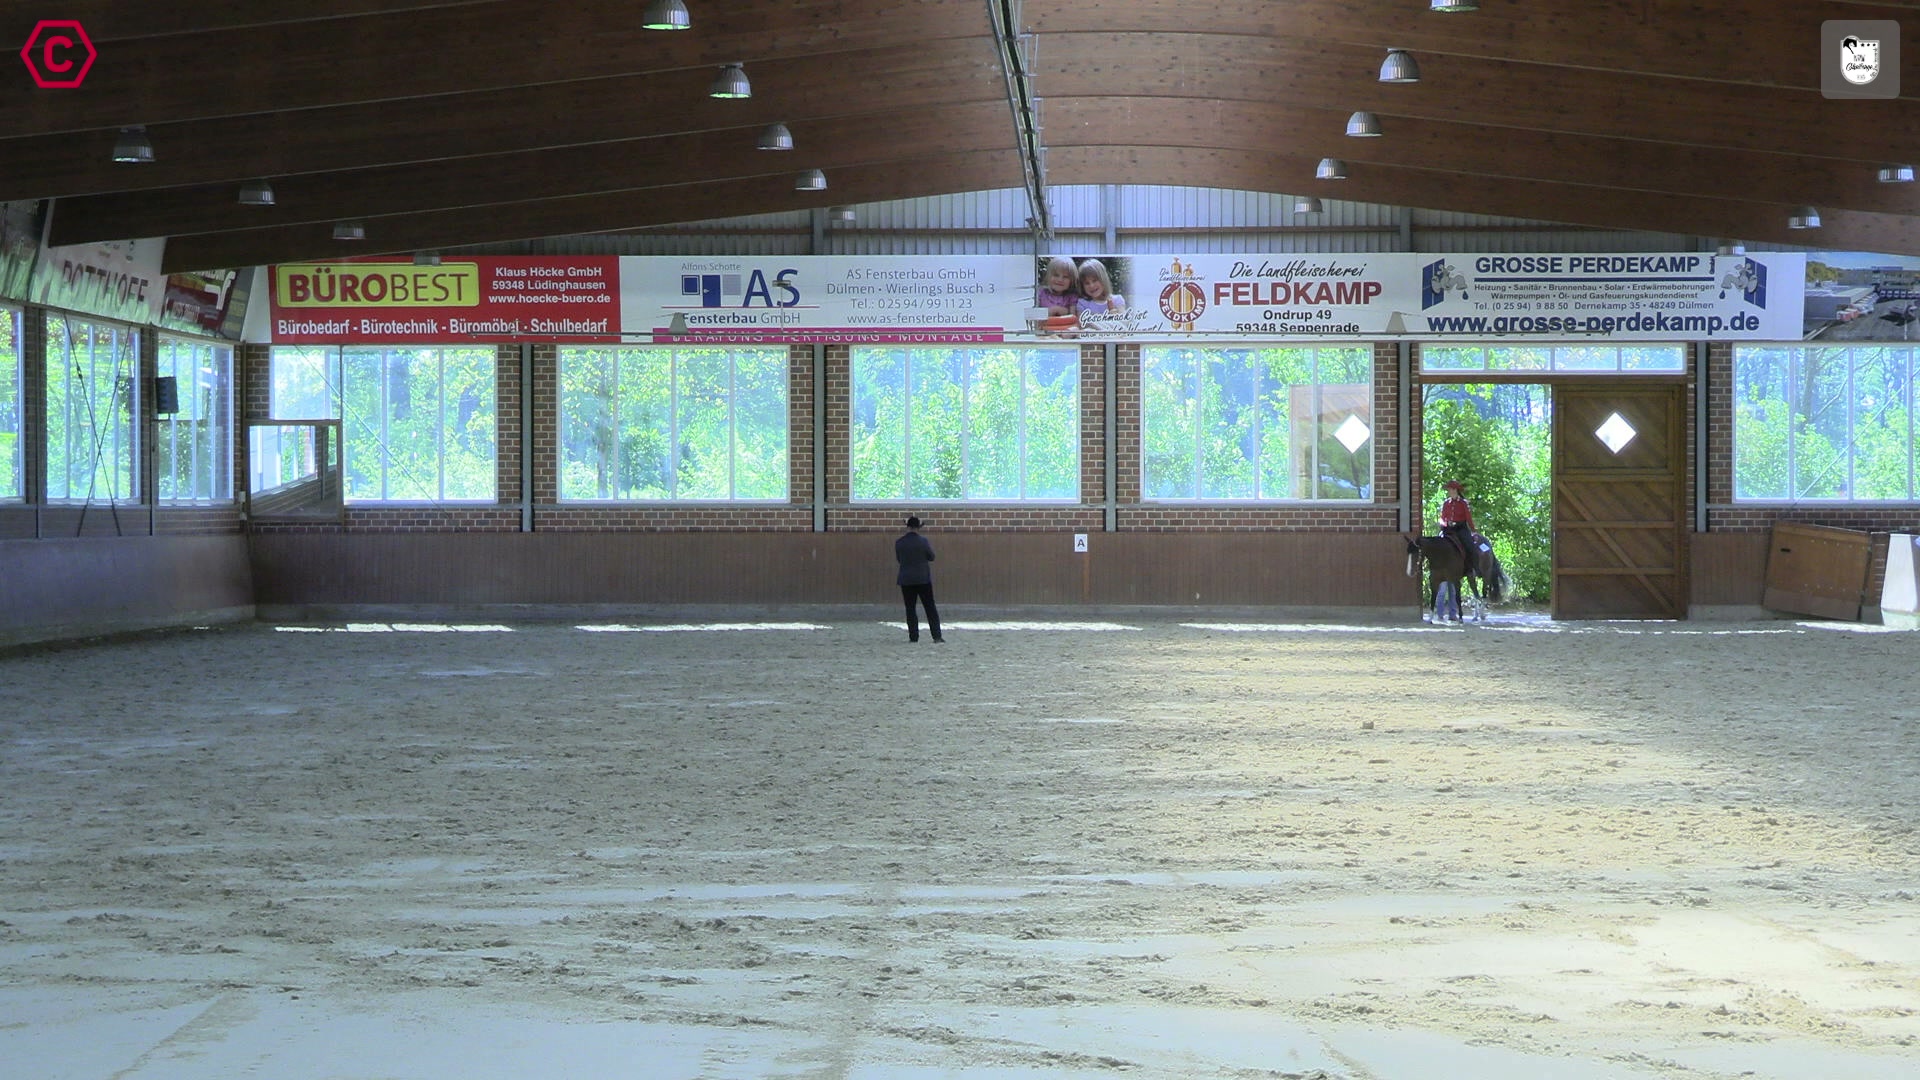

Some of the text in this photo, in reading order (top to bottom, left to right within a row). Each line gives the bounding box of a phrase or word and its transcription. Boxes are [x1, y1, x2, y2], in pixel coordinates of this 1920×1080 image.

[681, 262, 741, 271] Alfons Schotte
[1475, 257, 1563, 274] GROSSE
[1569, 256, 1700, 273] PERDEKAMP
[495, 267, 602, 277] Klaus Höcke GmbH
[846, 268, 976, 280] AS Fensterbau GmbH
[1229, 260, 1367, 283] Die Landfleischerei
[289, 267, 469, 303] BÜROBEST
[492, 280, 606, 292] 59348 Lüdinghausen
[742, 269, 800, 308] AS
[827, 283, 995, 296] Dülmen Wierlings Busch 3
[1474, 284, 1506, 292] Heizung
[1632, 284, 1715, 292] Erdwärmebohrungen
[488, 294, 611, 304] www.hoecke-buero.de
[1213, 281, 1382, 306] FELDKAMP
[1491, 292, 1551, 300] Wärmepumpen
[1589, 292, 1698, 300] Gasfeuerungskundendienst
[851, 299, 874, 309] Tel.:
[1160, 298, 1205, 322] FELDKAMP
[1475, 302, 1490, 310] Tel.
[1574, 302, 1627, 311] Dernekamp
[1649, 301, 1676, 309] 48249
[1679, 301, 1714, 309] Dülmen
[682, 312, 800, 324] Fensterbau GmbH
[847, 313, 976, 324] www.as-fensterbau.de
[1263, 309, 1332, 322] Ondrup 49
[278, 318, 608, 335] Bürobedarf Bürotechnik Büromöbel Schulbedarf
[1236, 323, 1360, 333] 59348 Seppenrade
[1427, 311, 1760, 336] www.grosse-perdekamp.de
[1077, 539, 1085, 548] A
